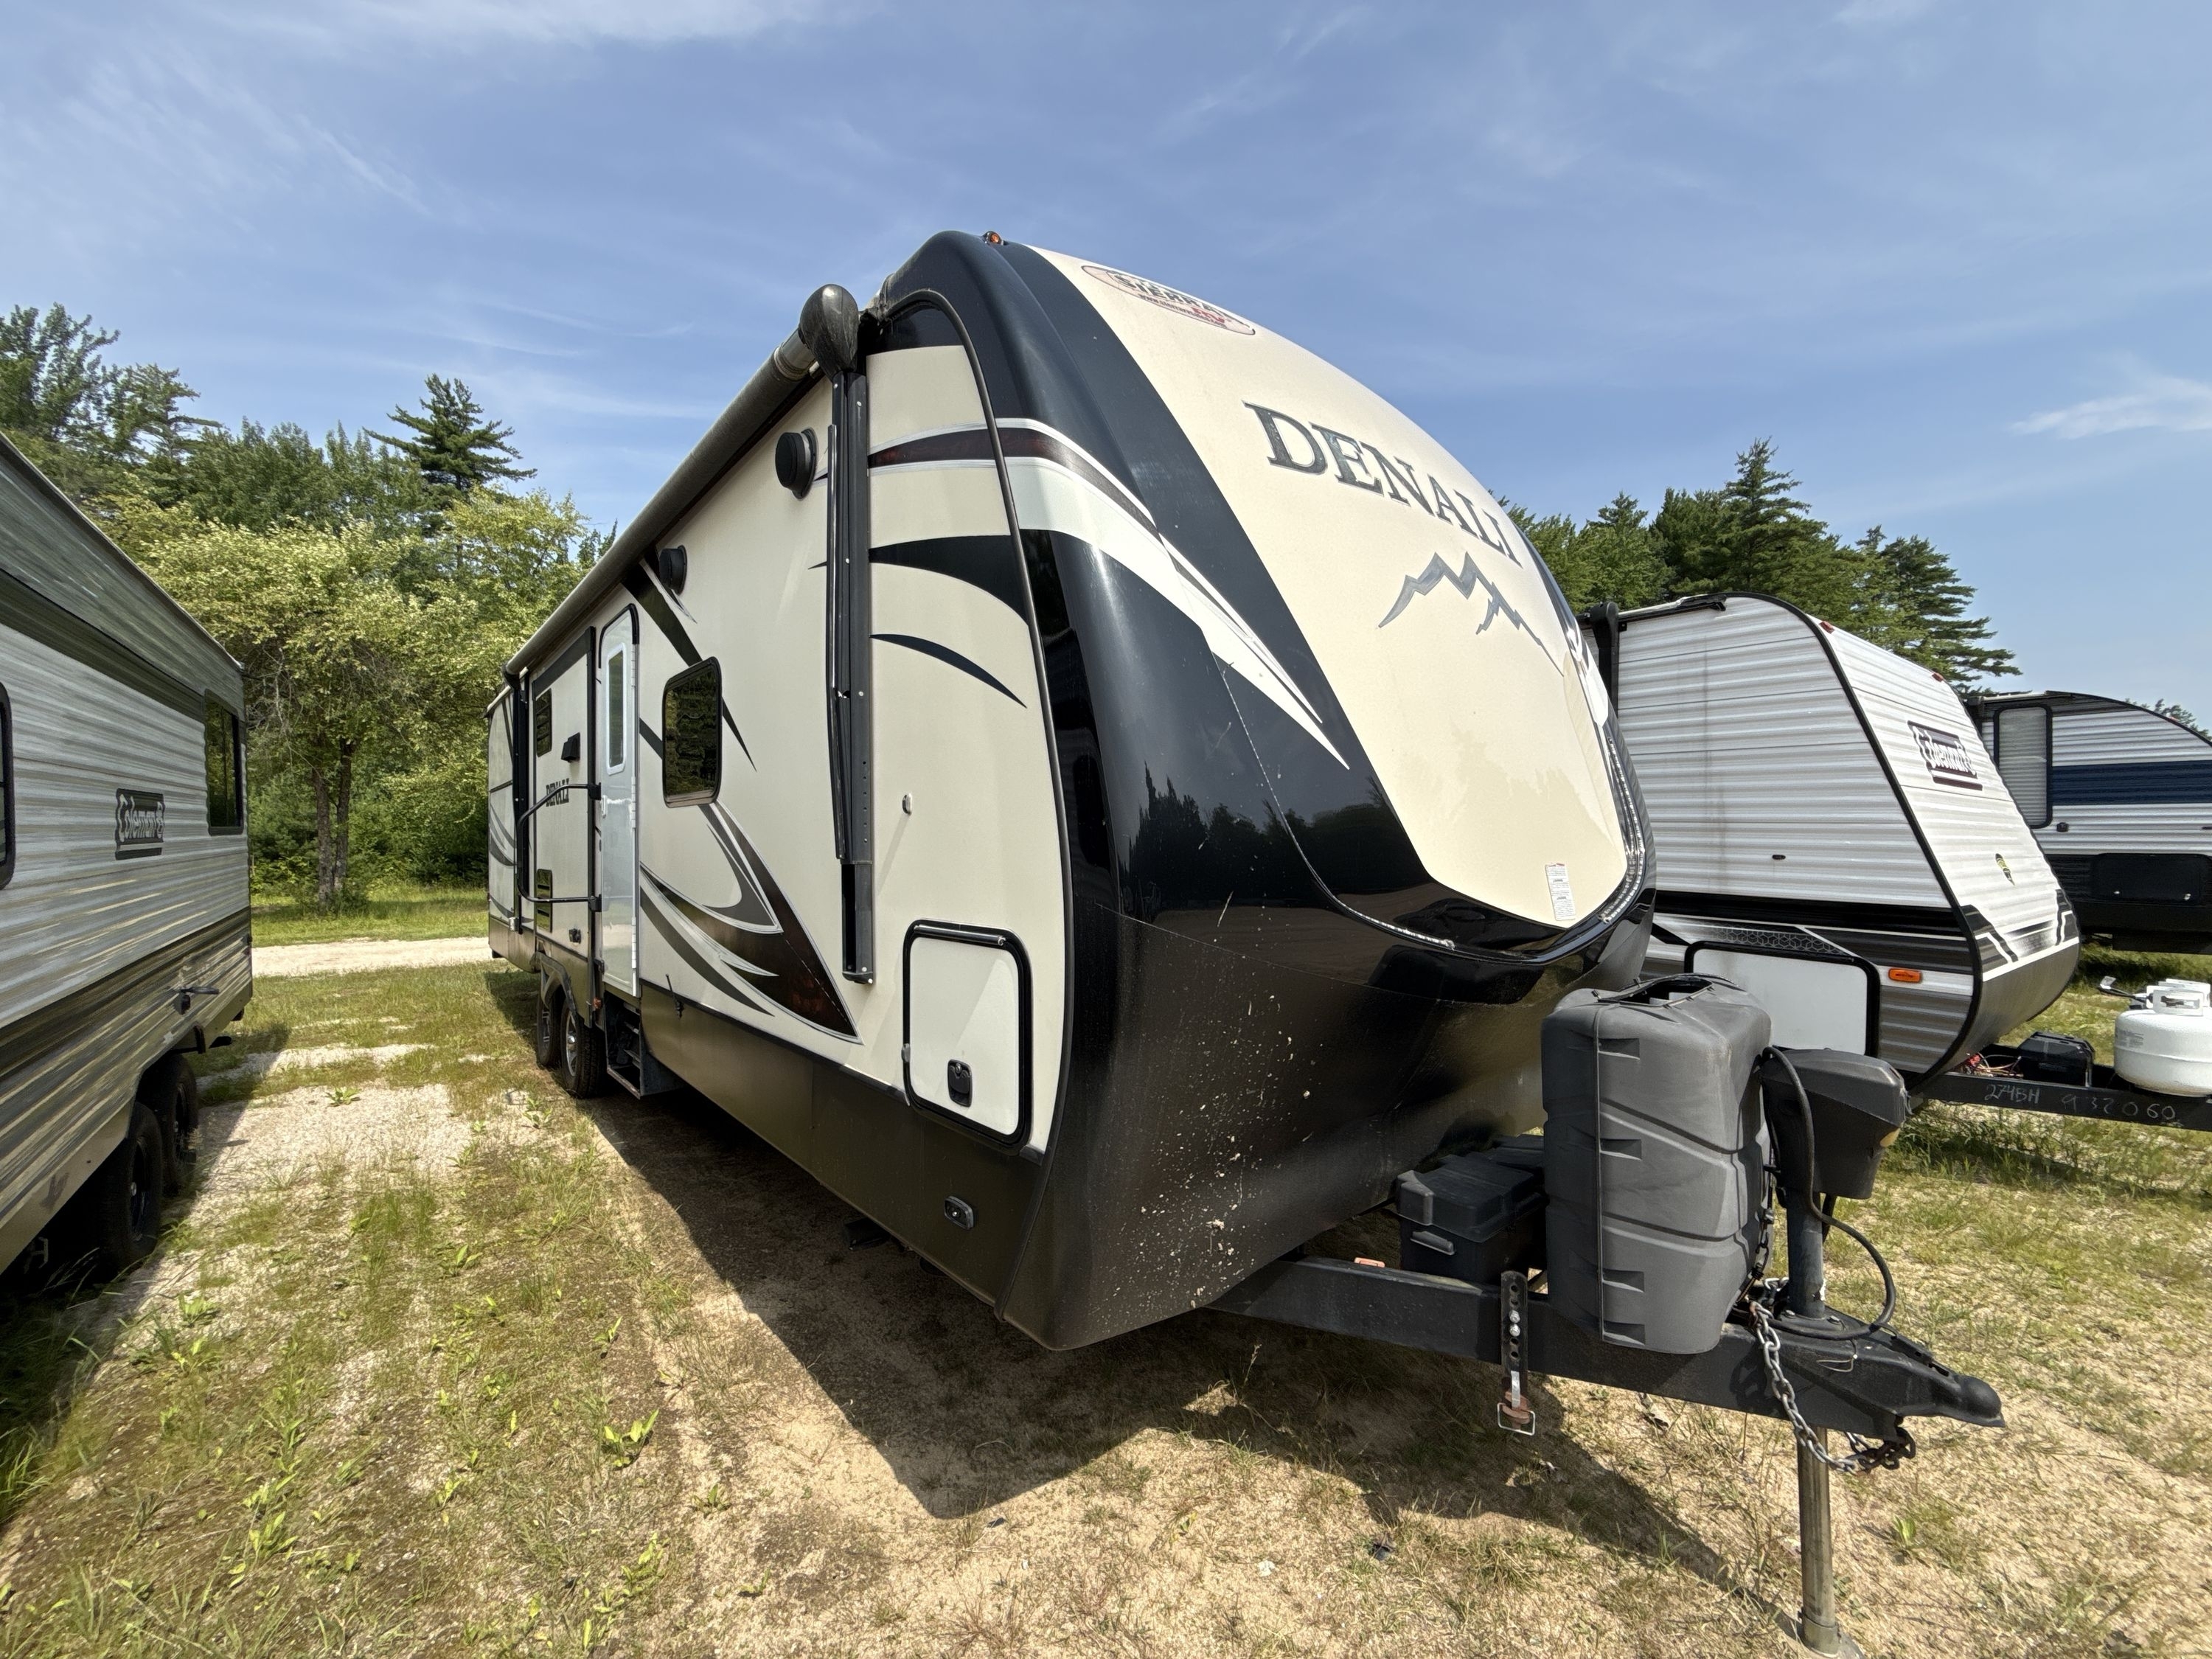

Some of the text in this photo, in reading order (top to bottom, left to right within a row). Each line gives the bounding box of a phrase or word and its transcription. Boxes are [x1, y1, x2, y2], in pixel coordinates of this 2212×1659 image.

[1242, 400, 1523, 568] DENALI
[1912, 726, 1970, 773] Coleman
[546, 778, 569, 807] DENALI
[117, 793, 157, 843] Coleman
